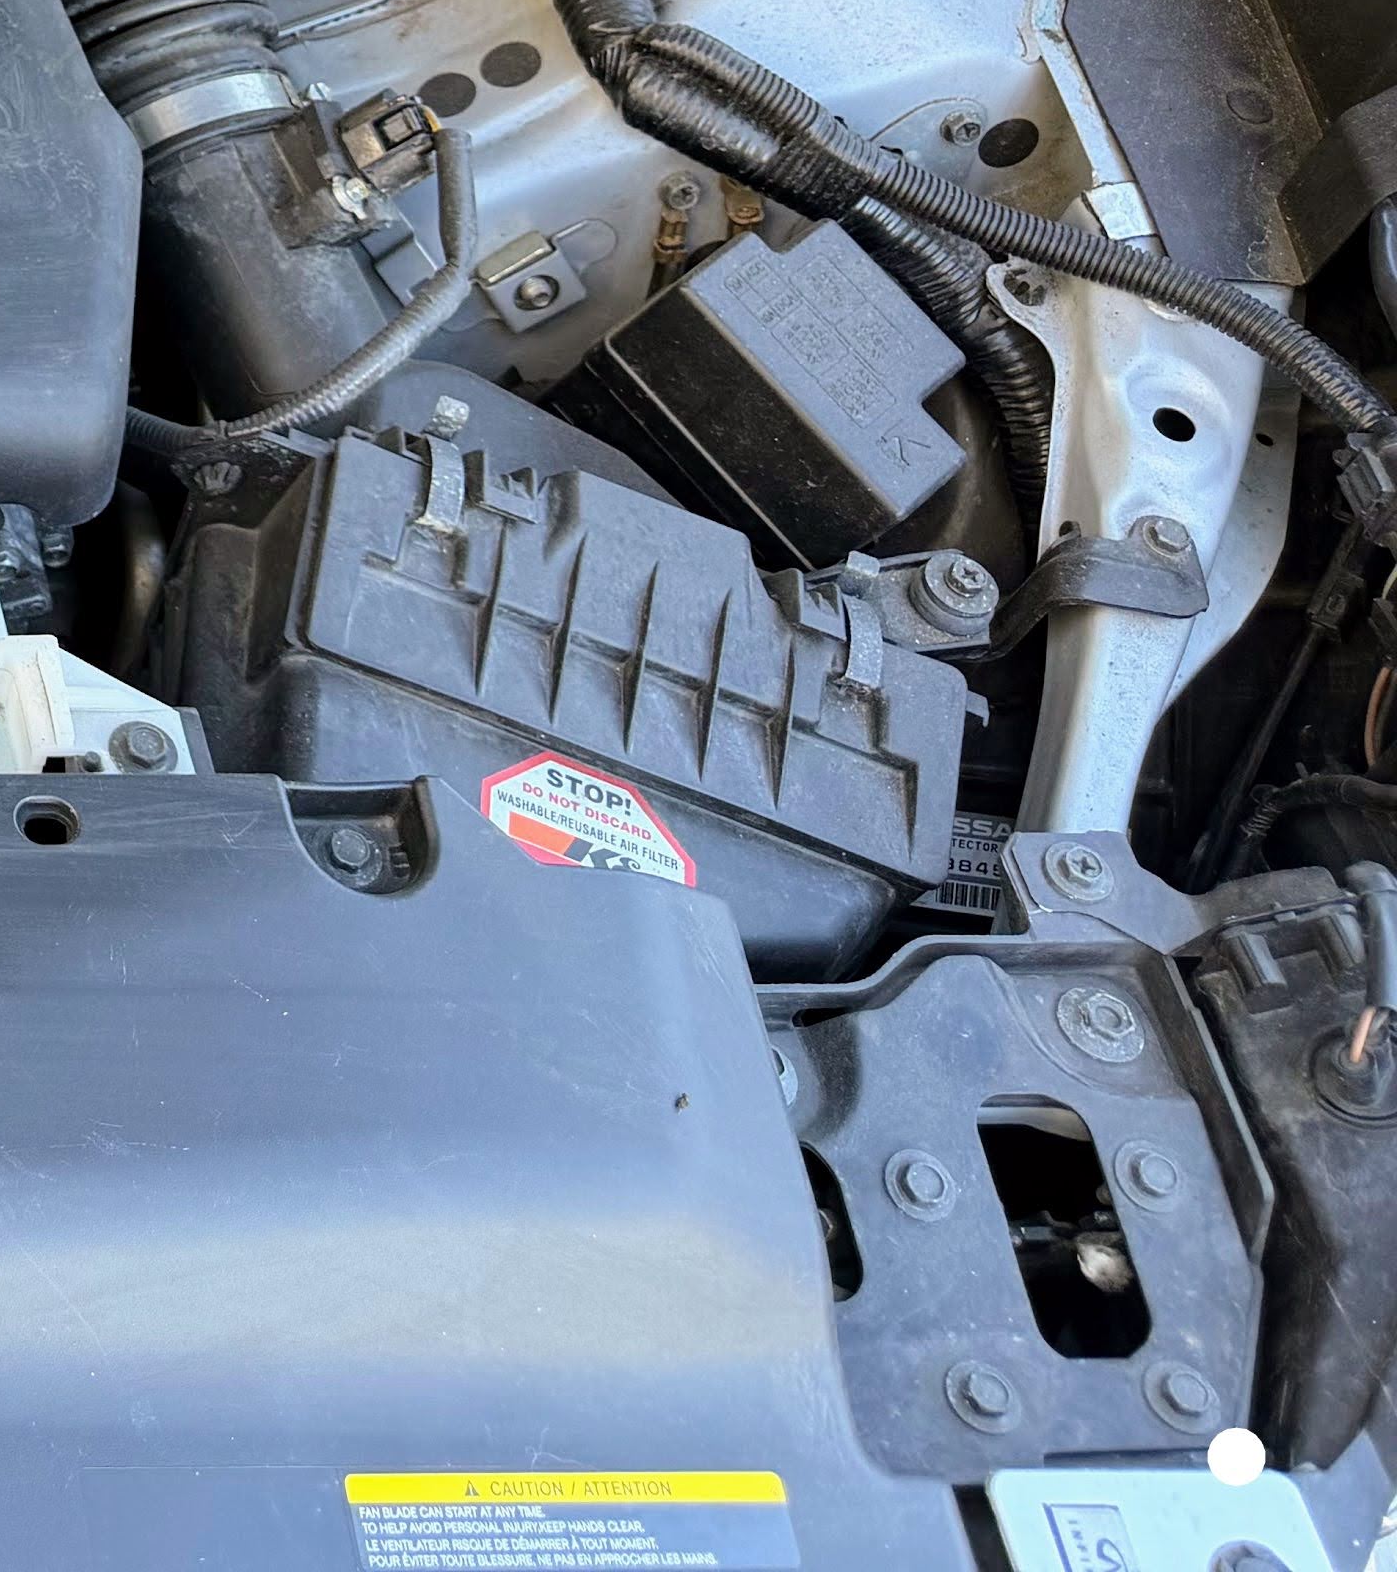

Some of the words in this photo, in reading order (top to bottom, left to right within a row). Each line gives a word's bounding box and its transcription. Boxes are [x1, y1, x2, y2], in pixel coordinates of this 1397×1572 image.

[523, 782, 543, 798] DO
[549, 793, 580, 812] NOT
[547, 768, 631, 816] STOP!
[498, 790, 616, 846] WASHABLE/REUSABLE
[620, 839, 639, 855] AIR
[642, 847, 678, 870] FILTER
[490, 1480, 564, 1497] CAUTION
[584, 1480, 671, 1497] ATTENTION
[359, 1507, 380, 1519] FAN
[383, 1507, 417, 1519] BLADE
[419, 1506, 443, 1518] CAN
[445, 1506, 478, 1518] START
[480, 1506, 492, 1518] AT
[495, 1506, 516, 1518] ANY
[519, 1506, 545, 1518] TIME.
[362, 1522, 377, 1534] TO
[379, 1522, 406, 1534] HELP
[410, 1522, 442, 1534] AVOID
[444, 1521, 502, 1533] PERSONAL
[569, 1520, 605, 1533] HANDS
[607, 1520, 645, 1533] CLEAR.
[365, 1539, 379, 1551] LE
[381, 1539, 452, 1551] VENTILATEUR
[453, 1539, 492, 1551] RISQUE
[495, 1538, 509, 1551] DE
[512, 1536, 569, 1551] DÉMARRER
[572, 1534, 579, 1550] À
[581, 1538, 607, 1550] TOUT
[611, 1537, 658, 1550] MOMENT.
[369, 1555, 400, 1567] POUR
[403, 1551, 438, 1567] ÉVITER
[440, 1554, 475, 1567] TOUTE
[477, 1554, 536, 1567] BLESSURE,
[538, 1554, 552, 1566] NE
[555, 1553, 576, 1566] PAS
[578, 1553, 593, 1566] EN
[595, 1553, 660, 1565] APPROCHER
[661, 1553, 681, 1565] LES
[683, 1552, 718, 1565] MAINS.
